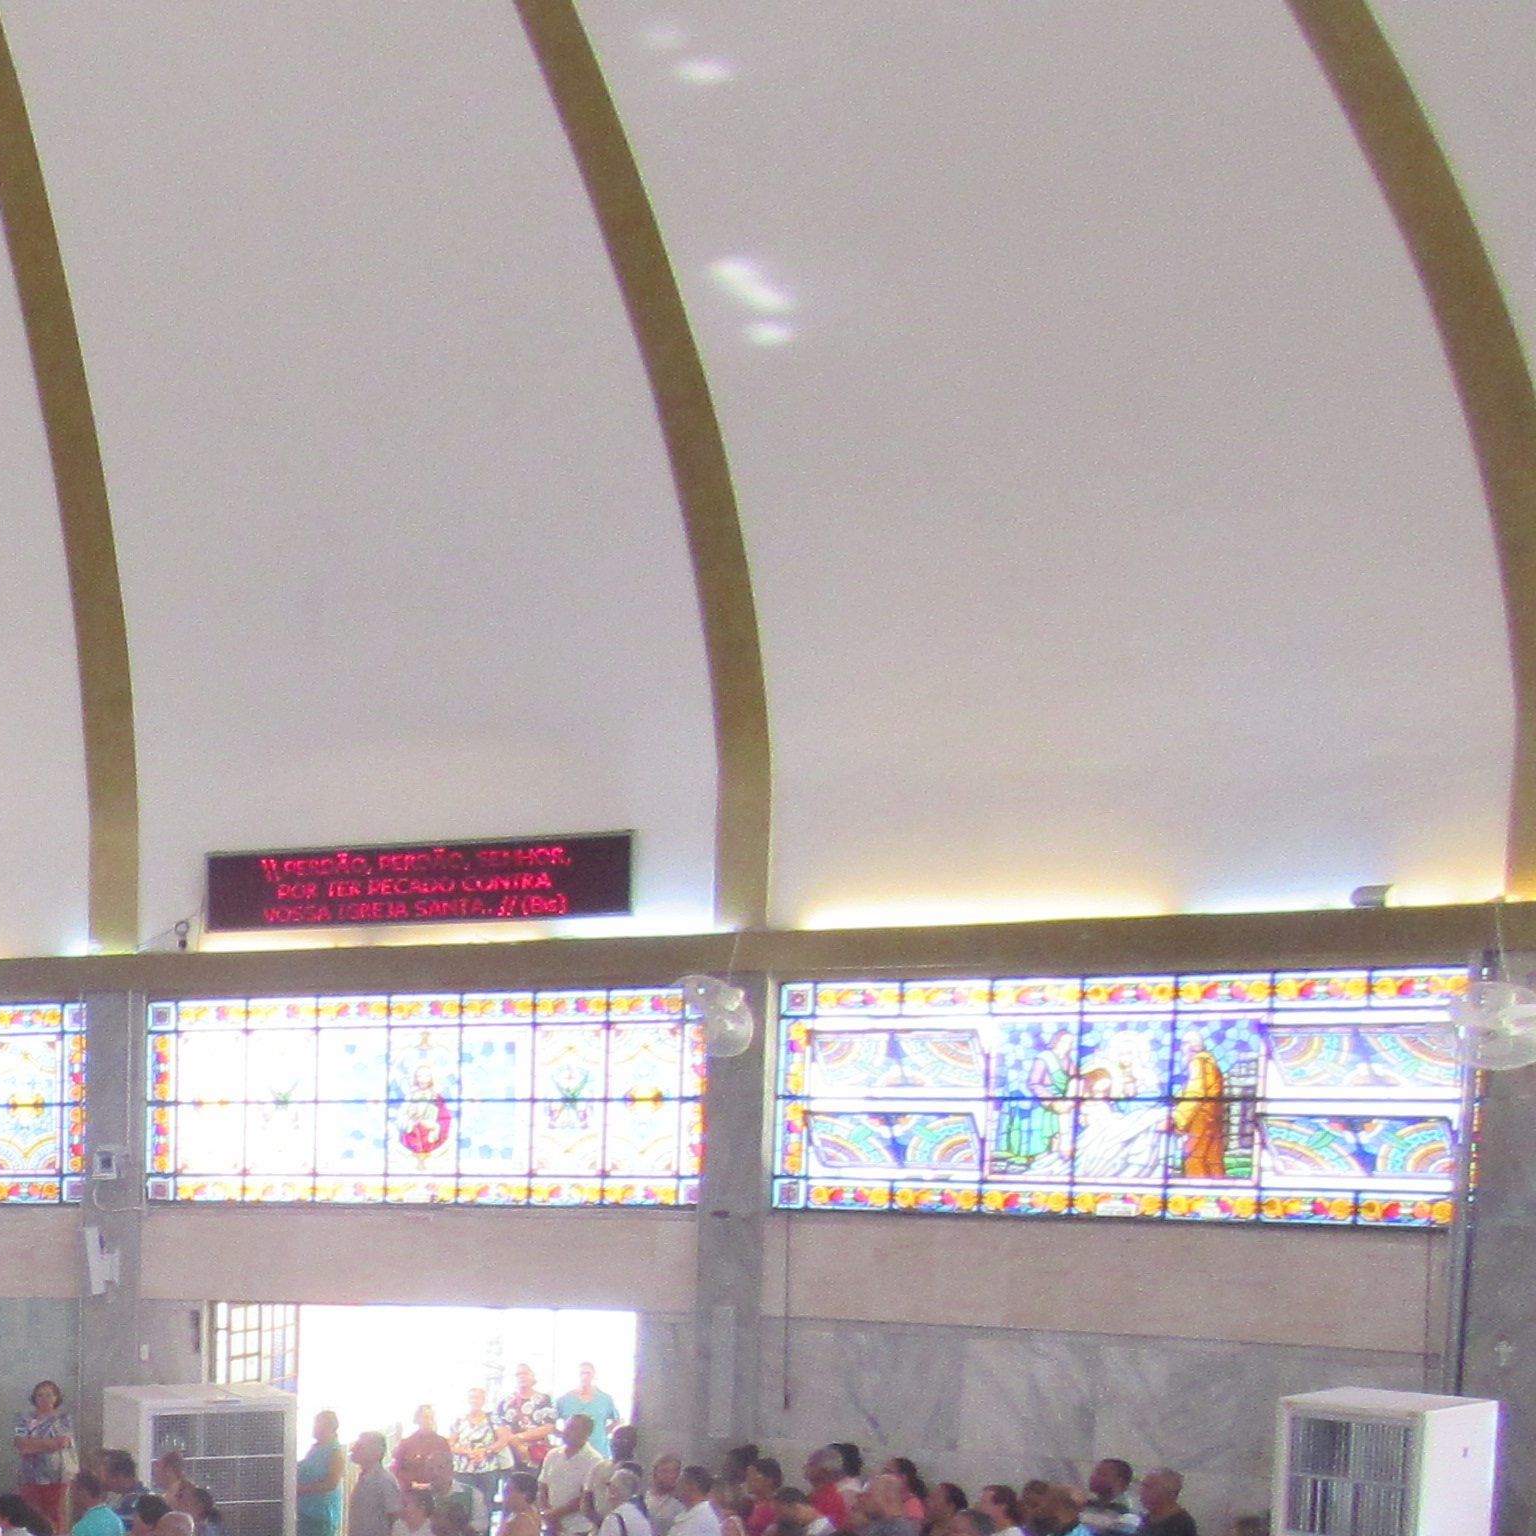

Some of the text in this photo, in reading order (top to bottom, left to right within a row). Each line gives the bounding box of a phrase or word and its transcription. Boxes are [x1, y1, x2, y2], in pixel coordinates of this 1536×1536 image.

[277, 872, 552, 900] POR TER PECADO CONTRA
[263, 905, 331, 923] VOSSA
[339, 901, 408, 921] IGREJA
